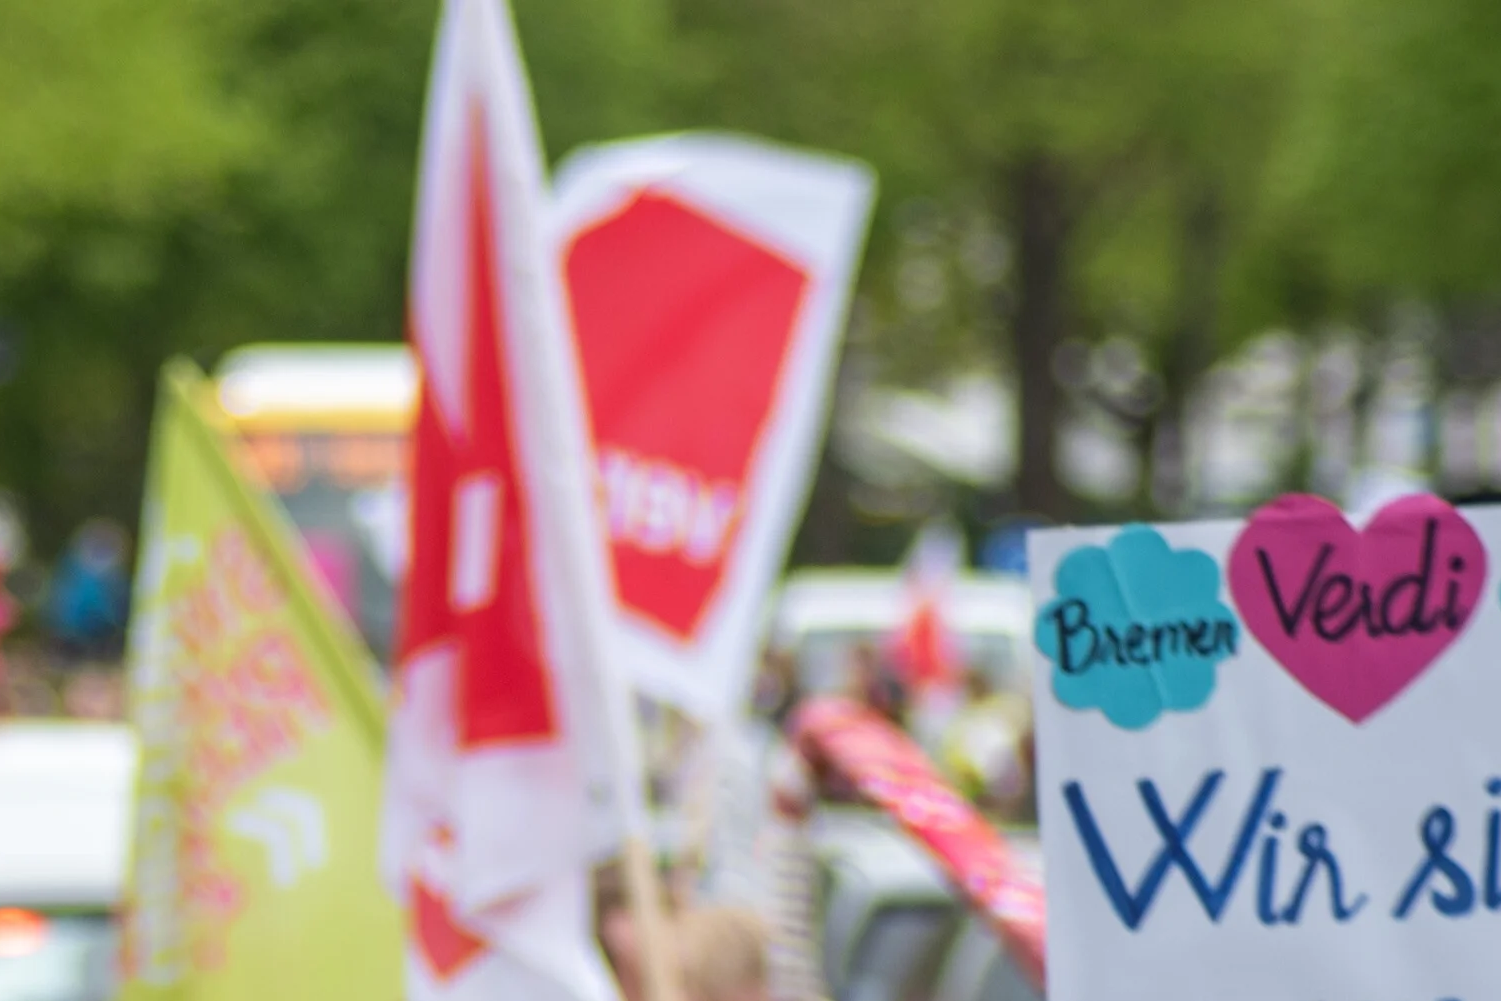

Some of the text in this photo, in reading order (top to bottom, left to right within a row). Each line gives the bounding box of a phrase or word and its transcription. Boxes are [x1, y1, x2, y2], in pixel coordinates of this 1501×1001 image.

[1046, 599, 1238, 677] Bremen
[1256, 518, 1470, 642] Verdi
[1062, 766, 1368, 932] Wir
